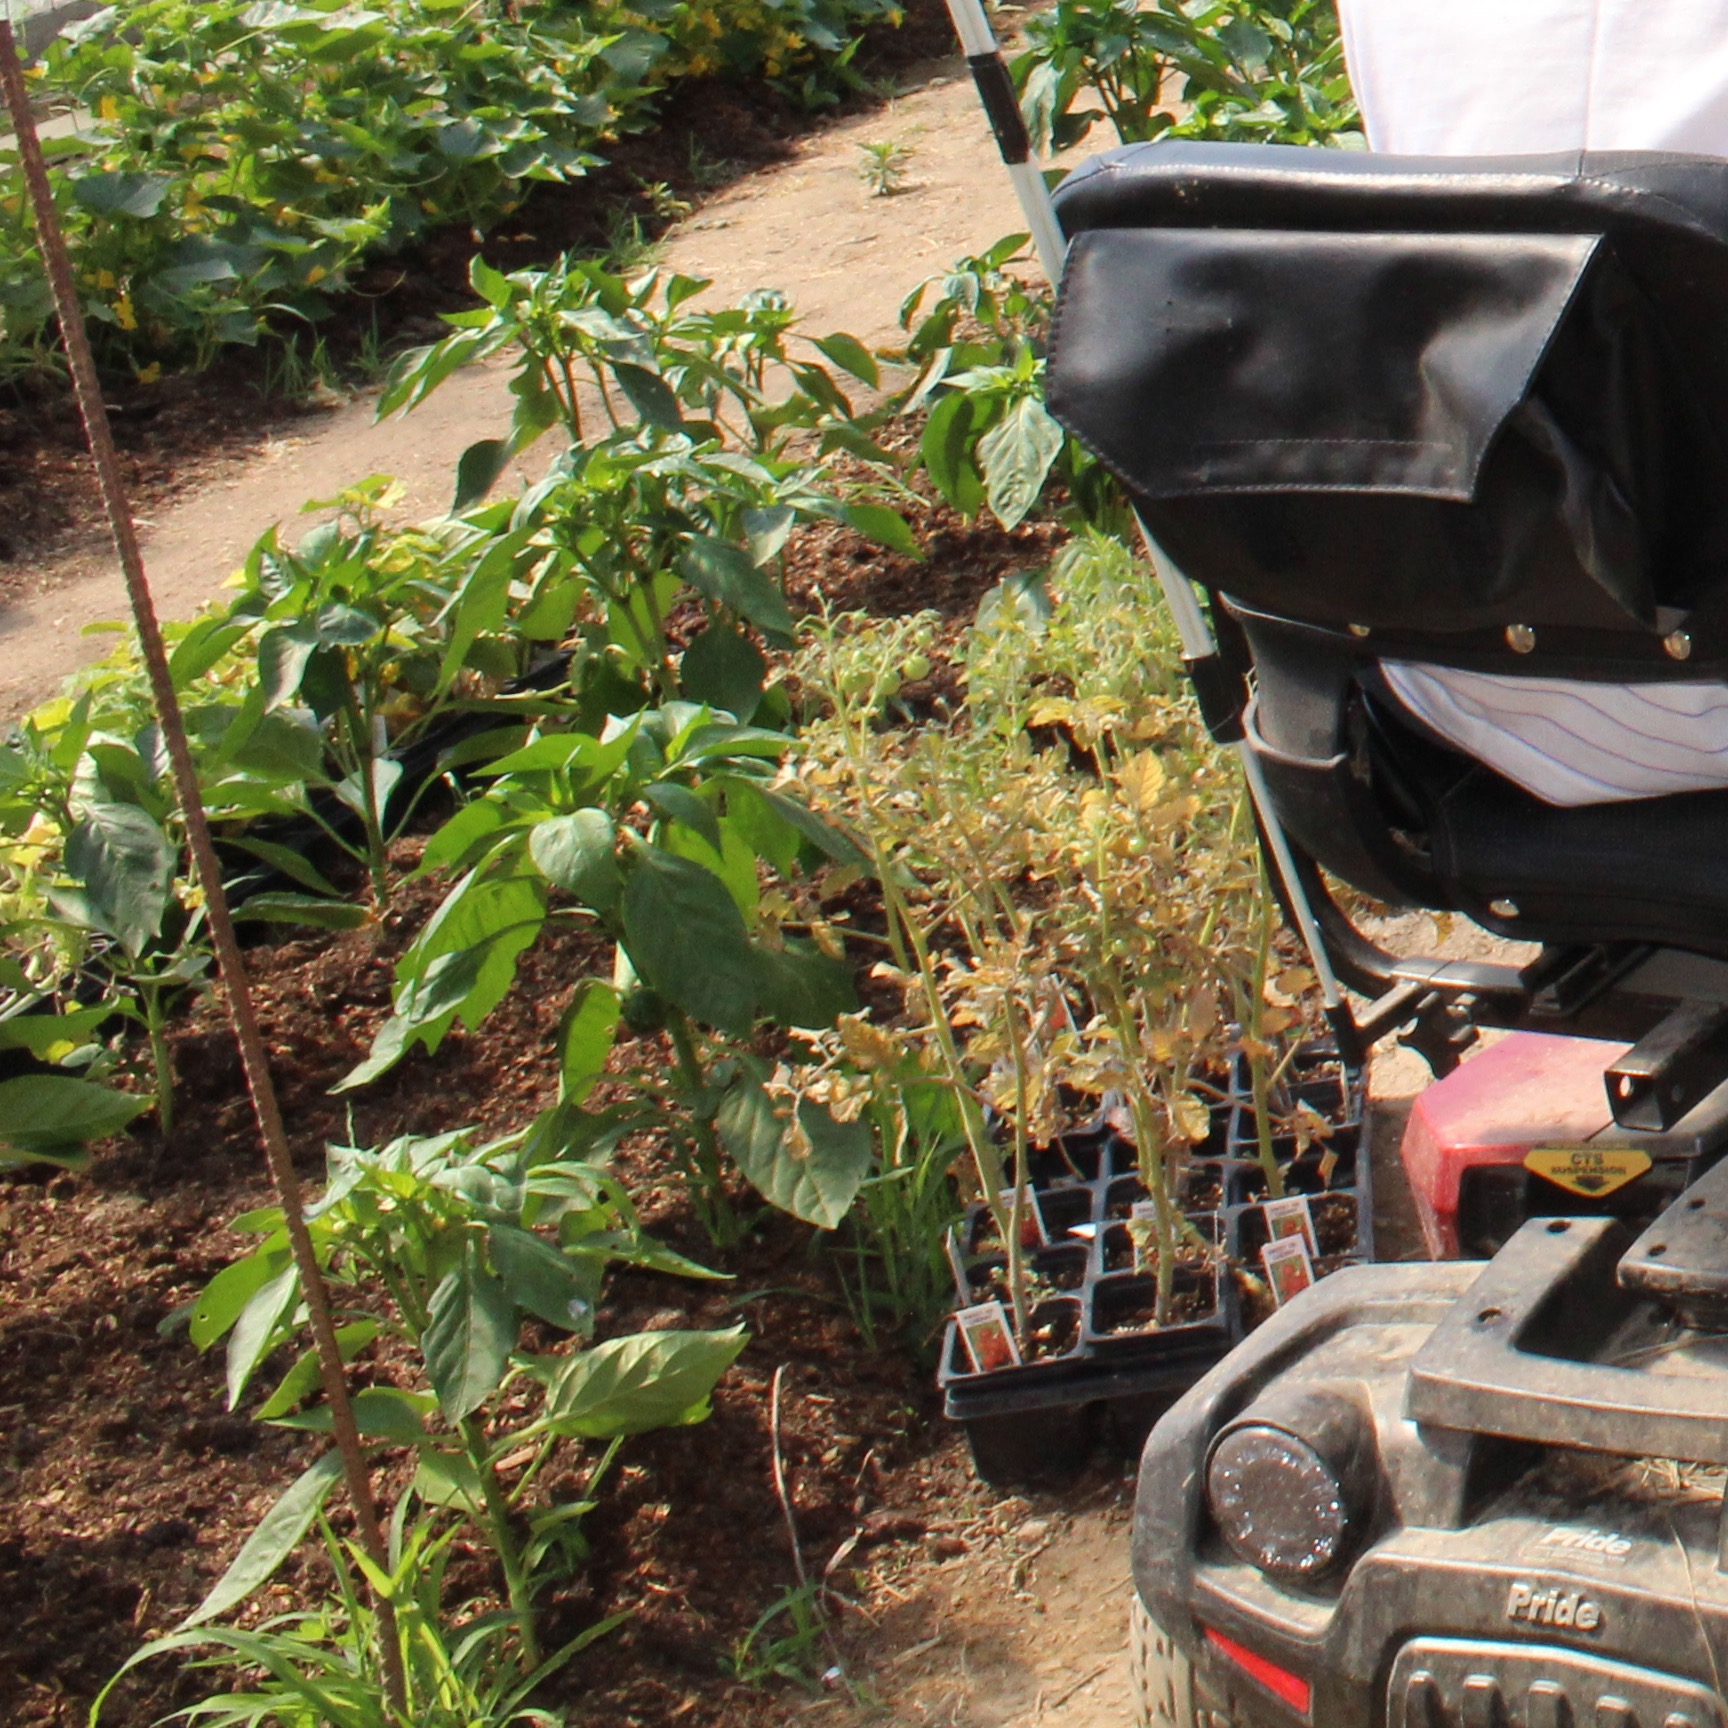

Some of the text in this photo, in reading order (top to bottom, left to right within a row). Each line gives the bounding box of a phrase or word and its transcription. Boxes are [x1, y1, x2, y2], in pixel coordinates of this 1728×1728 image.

[1570, 1152, 1605, 1166] CTS
[1540, 1526, 1632, 1556] Pride
[1507, 1582, 1600, 1630] Pride
